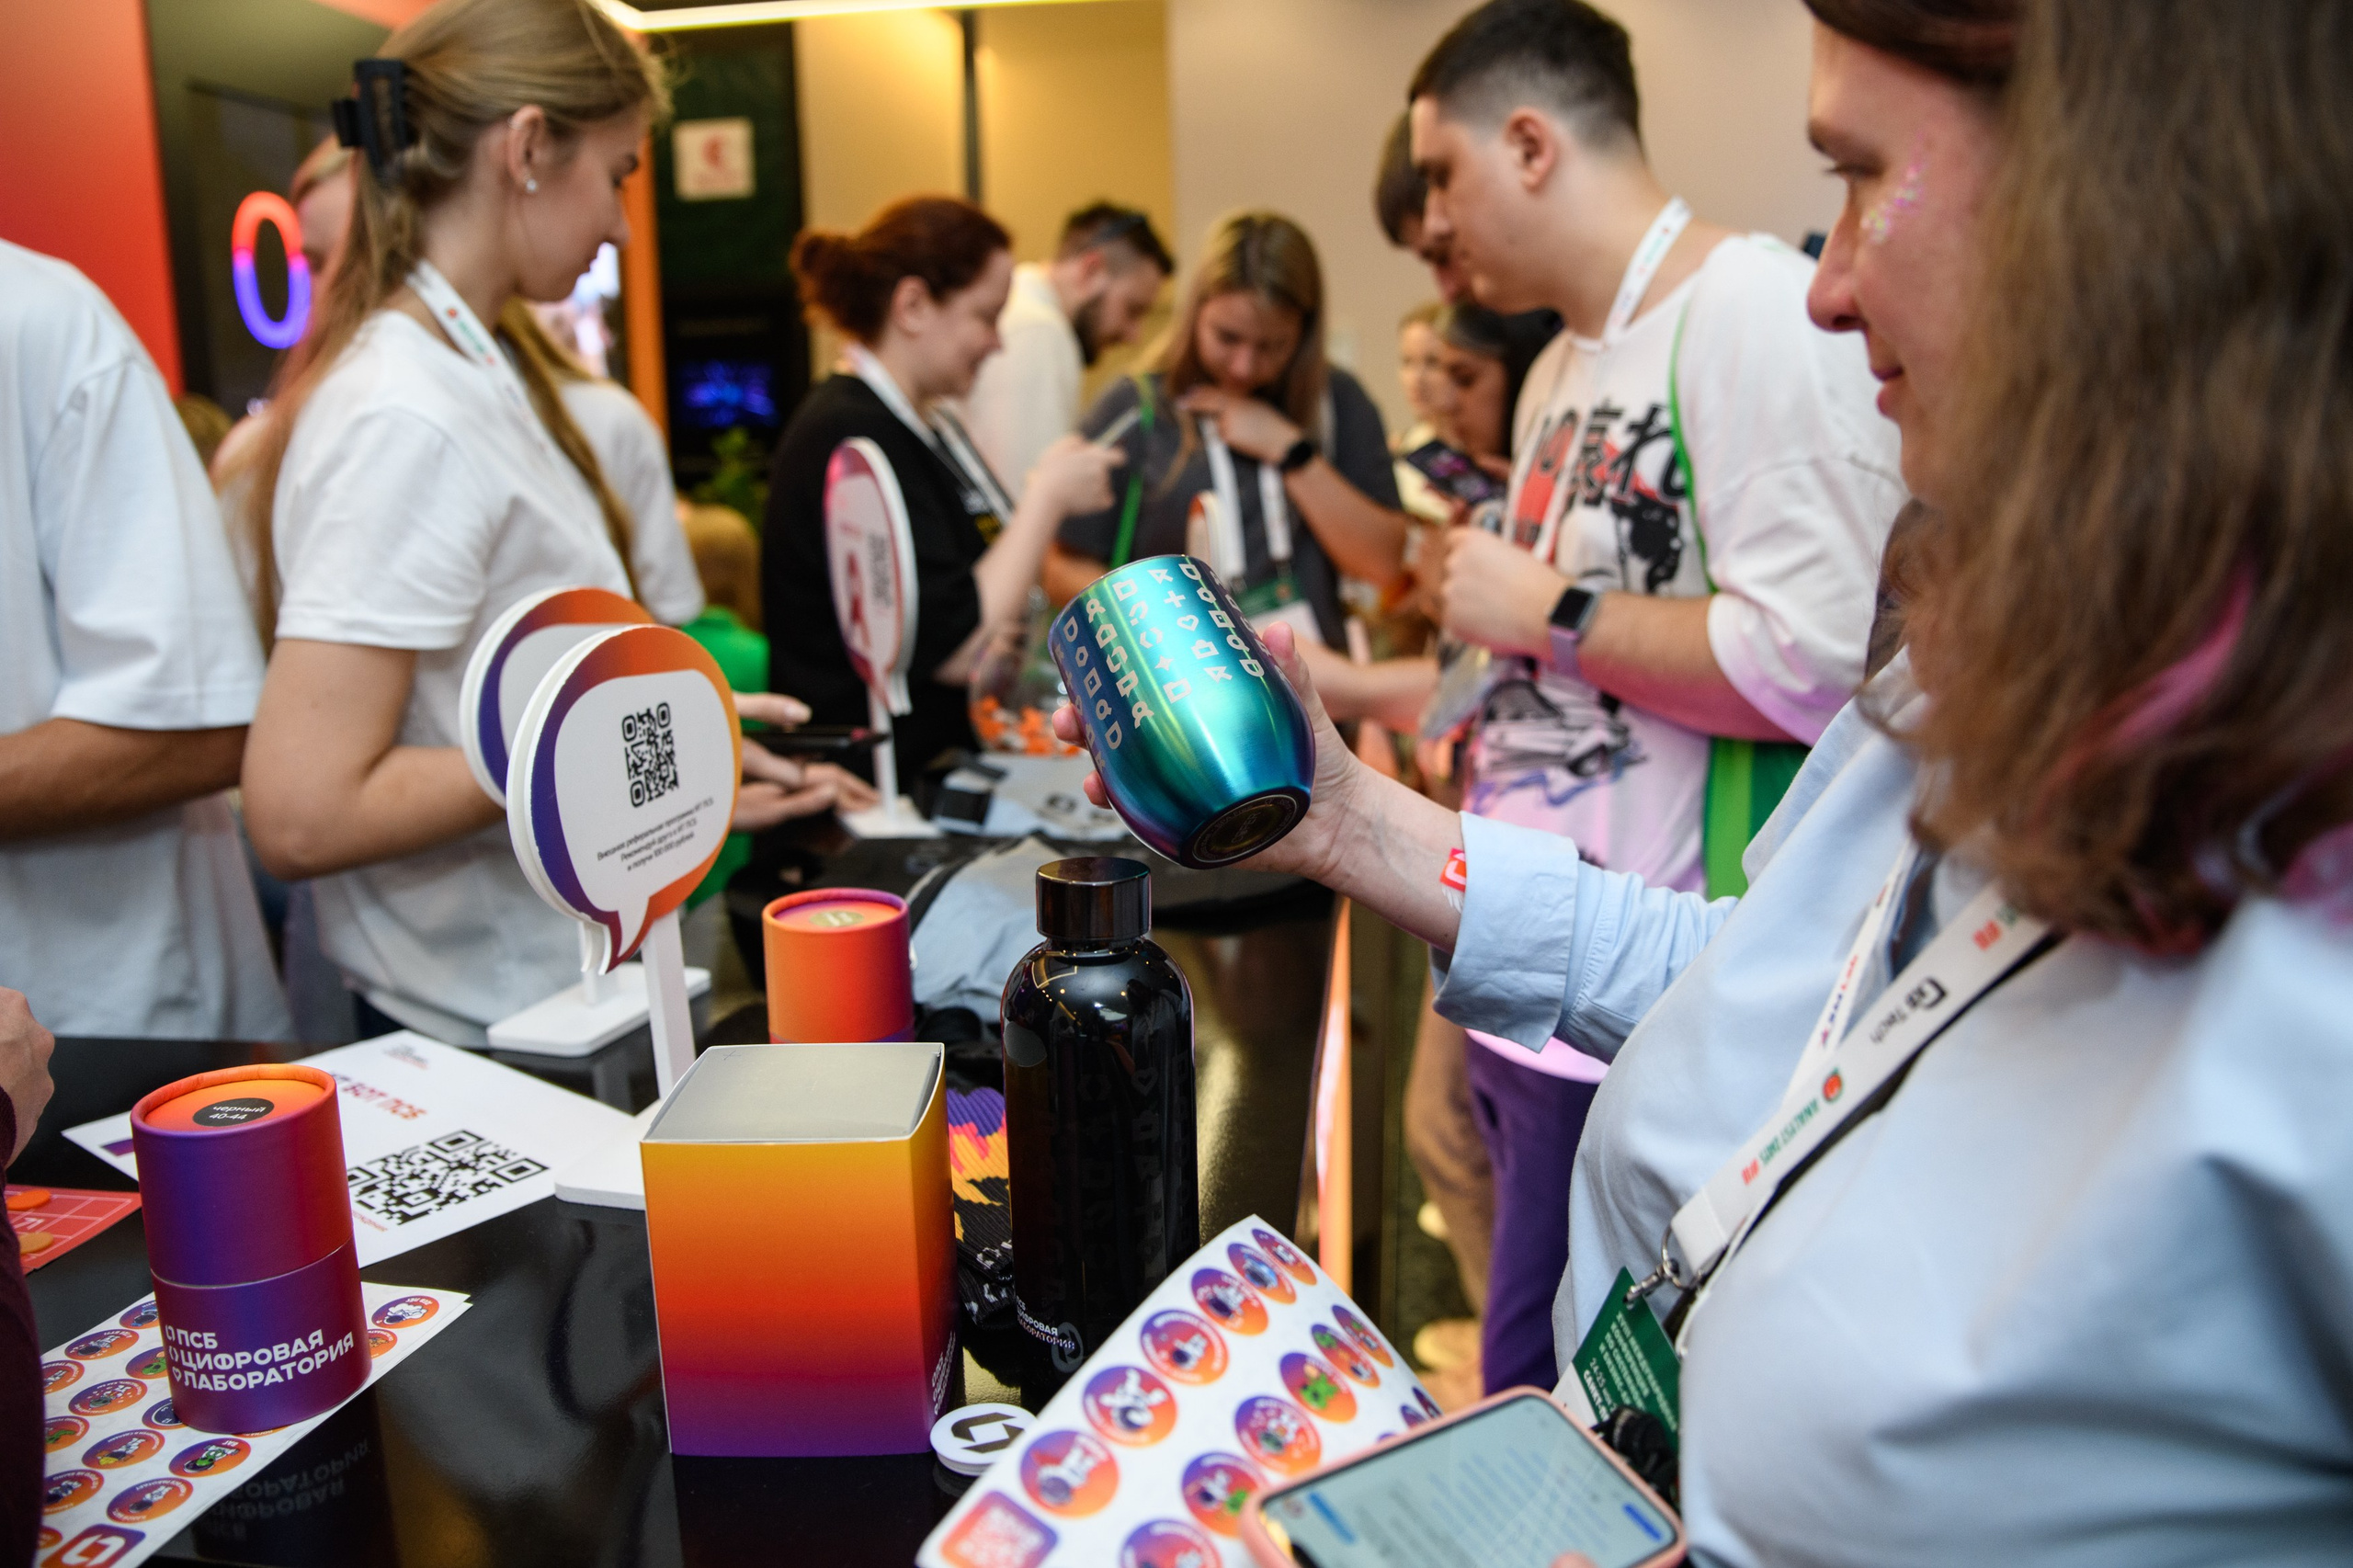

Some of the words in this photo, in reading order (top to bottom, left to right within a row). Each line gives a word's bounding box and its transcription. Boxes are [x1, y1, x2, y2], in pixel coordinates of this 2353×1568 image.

[209, 1112, 248, 1122] 40-44
[212, 1102, 267, 1115] черный
[1017, 1309, 1059, 1336] ЦИФРОВАЯ
[176, 1329, 218, 1350] ПСБ
[179, 1328, 324, 1371] ЦИФРОВАЯ
[184, 1331, 355, 1392] ЛАБОРАТОРИЯ
[1589, 1357, 1607, 1389] 24-25
